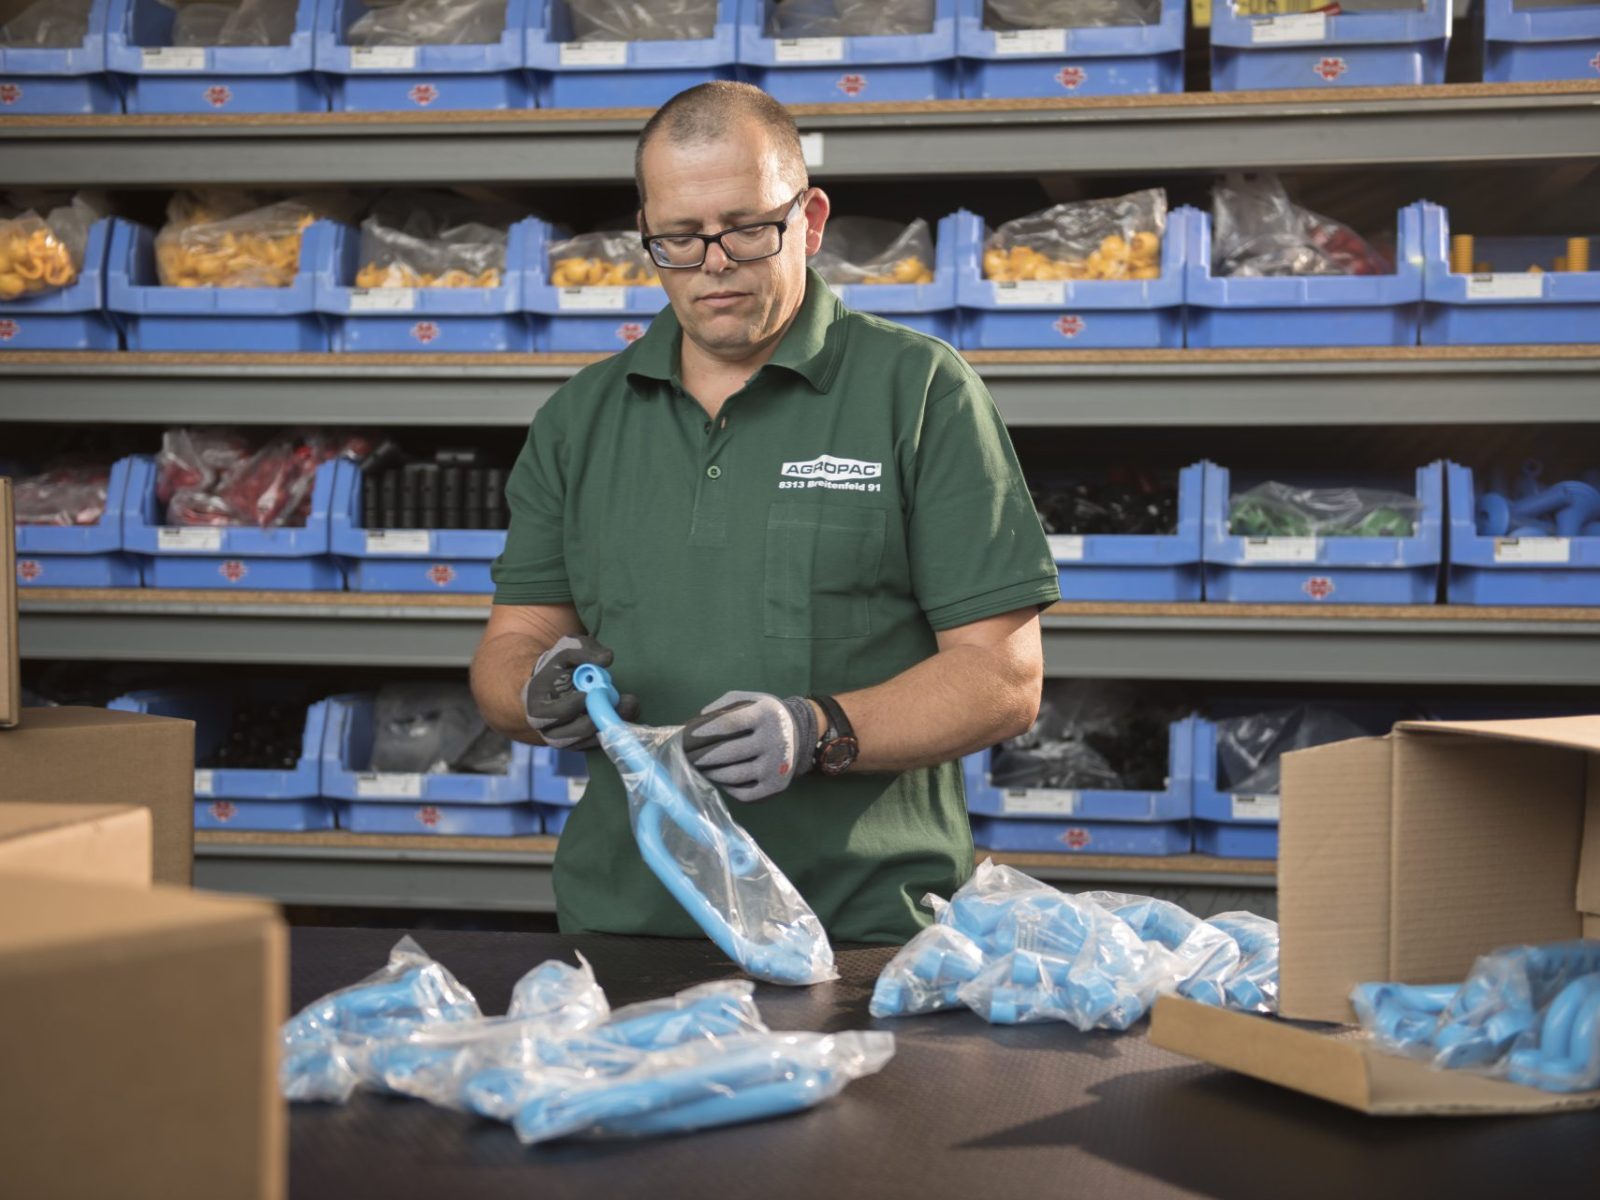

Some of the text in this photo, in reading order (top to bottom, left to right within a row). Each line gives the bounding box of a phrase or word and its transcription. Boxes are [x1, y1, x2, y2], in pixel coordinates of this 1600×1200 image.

[786, 461, 876, 476] AGROPAC
[779, 481, 805, 489] 8313
[868, 483, 881, 492] 91
